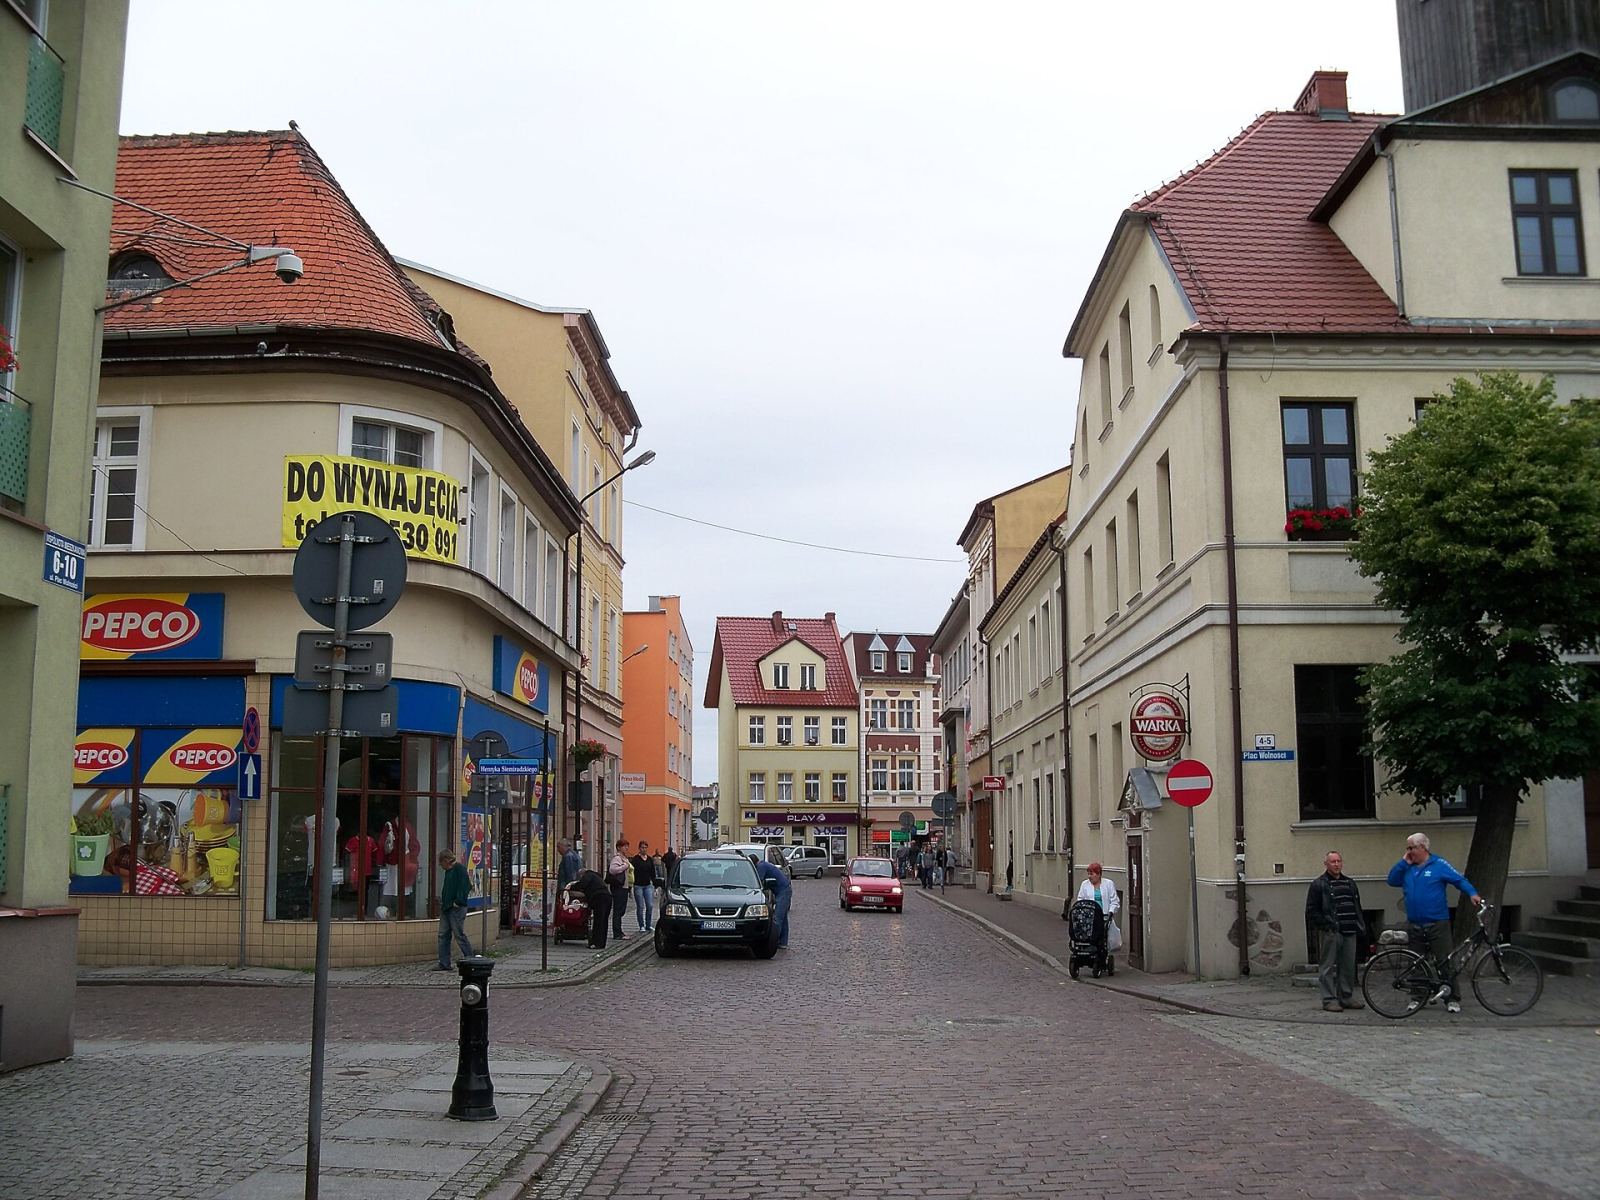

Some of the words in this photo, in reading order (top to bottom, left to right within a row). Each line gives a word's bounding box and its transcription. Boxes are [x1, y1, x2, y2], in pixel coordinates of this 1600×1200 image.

[287, 461, 326, 503] DO
[333, 462, 458, 528] WYNAJĘCIA
[434, 527, 457, 560] 091
[53, 550, 77, 580] 6-10
[83, 611, 189, 639] PEPCO
[521, 666, 537, 694] PEPCO
[1134, 719, 1181, 732] WARKA
[1259, 736, 1272, 745] 4-5
[174, 749, 232, 765] PEPCO
[1243, 752, 1258, 760] Plac
[787, 814, 816, 822] PLAY
